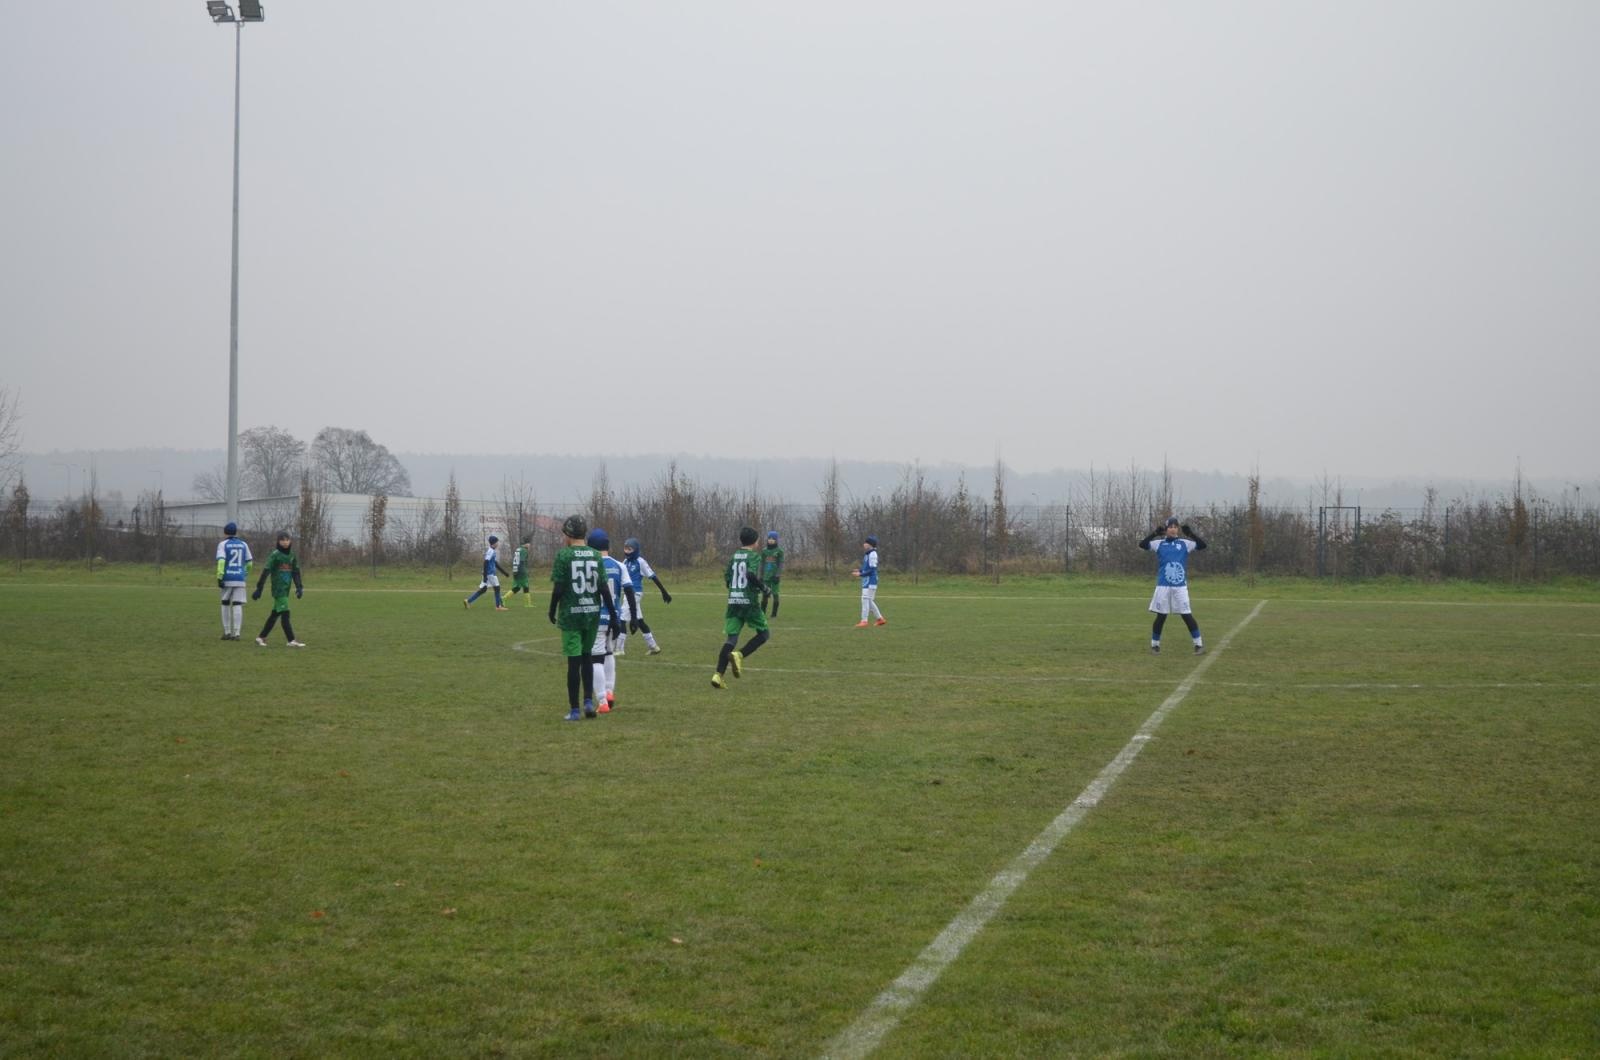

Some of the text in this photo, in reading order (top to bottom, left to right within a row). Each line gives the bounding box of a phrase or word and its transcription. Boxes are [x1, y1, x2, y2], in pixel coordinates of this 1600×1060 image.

[229, 548, 242, 566] 21
[571, 561, 599, 593] 55
[732, 562, 748, 588] 18
